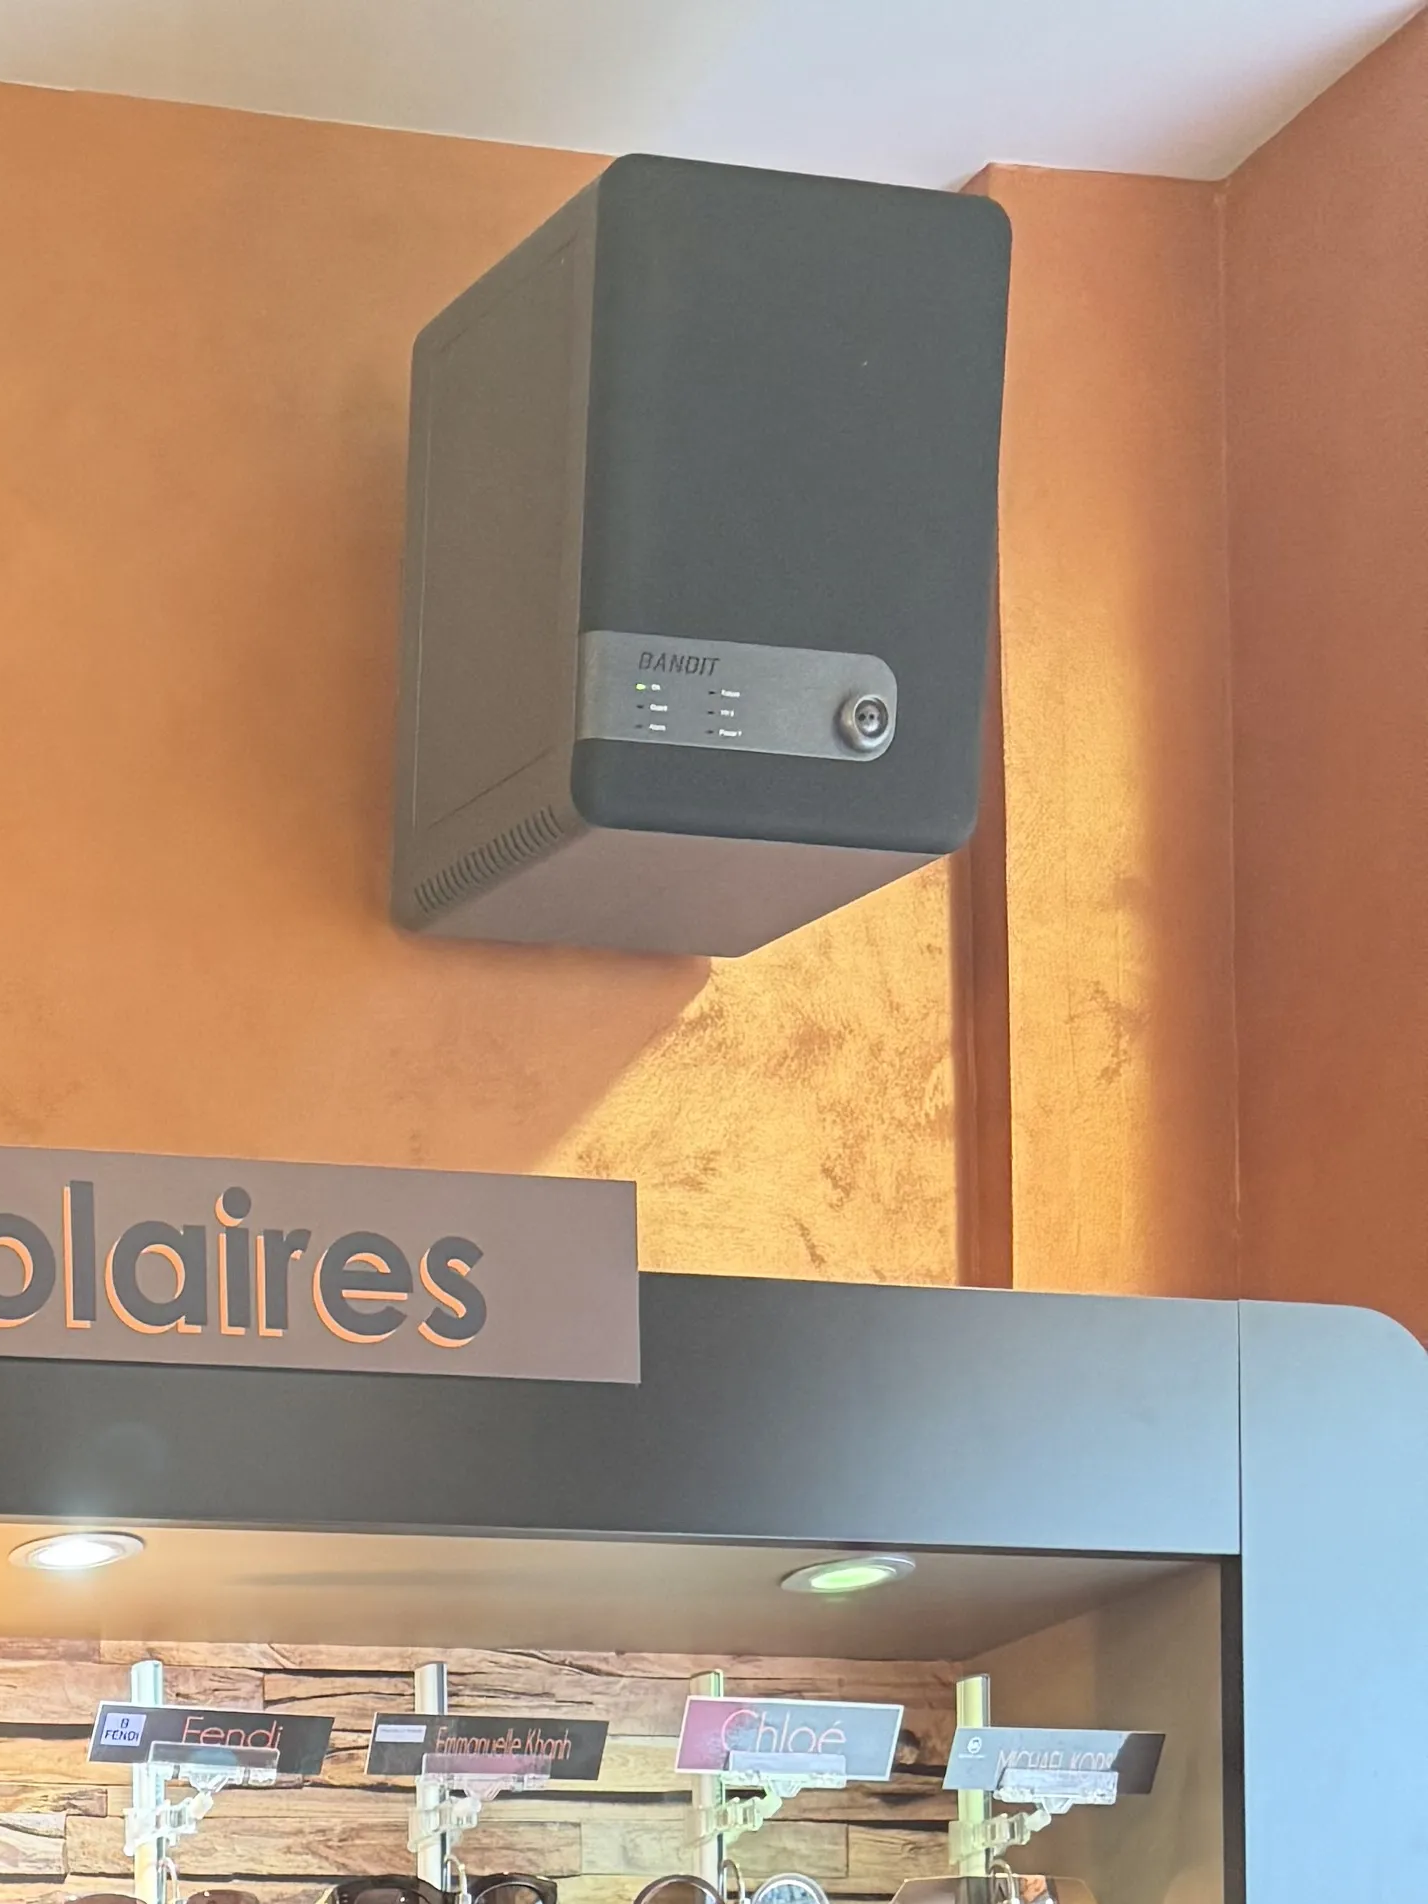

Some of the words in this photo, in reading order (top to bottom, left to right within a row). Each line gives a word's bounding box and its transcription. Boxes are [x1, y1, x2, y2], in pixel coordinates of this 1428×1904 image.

[638, 651, 721, 676] BANDIT
[104, 1729, 140, 1742] FENDI
[180, 1714, 284, 1750] Fendi
[435, 1726, 522, 1756] Emmanuelle
[524, 1727, 572, 1760] Khanh
[720, 1709, 847, 1754] Chloé
